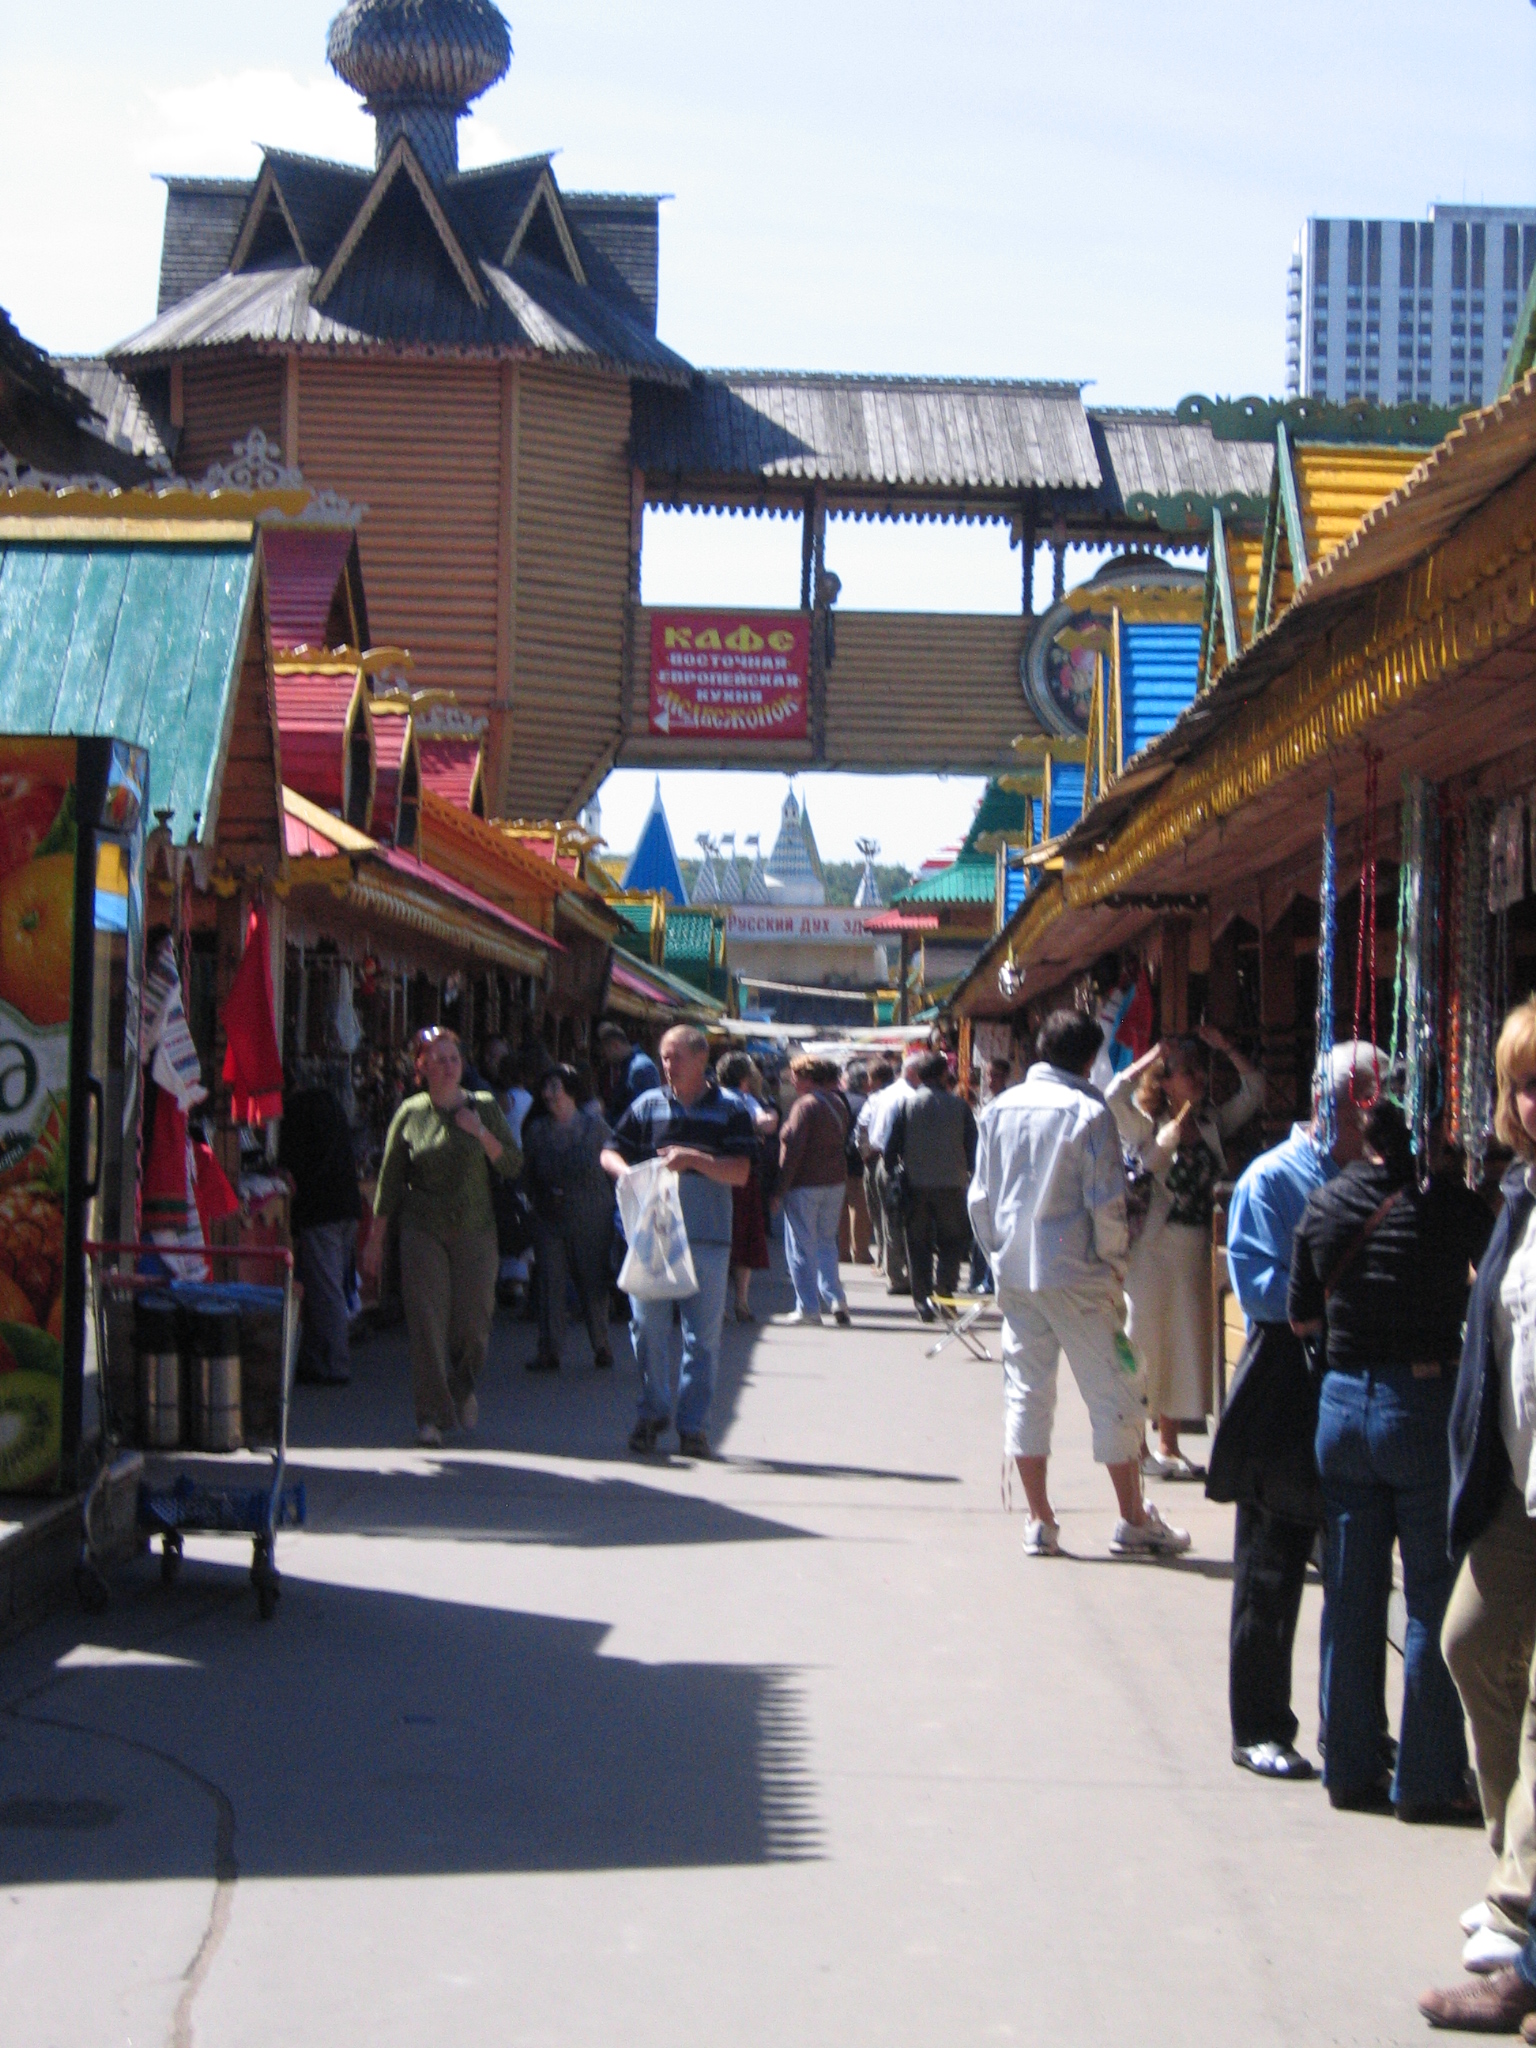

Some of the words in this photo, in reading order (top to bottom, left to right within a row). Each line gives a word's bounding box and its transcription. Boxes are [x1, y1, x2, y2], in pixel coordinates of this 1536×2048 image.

[664, 624, 795, 653] КАФЕ
[669, 652, 787, 670] ВОСТОЧНАЯ
[658, 669, 800, 688] ЕВРОПЕЙСКАЯ
[696, 688, 763, 703] КУХНЯ
